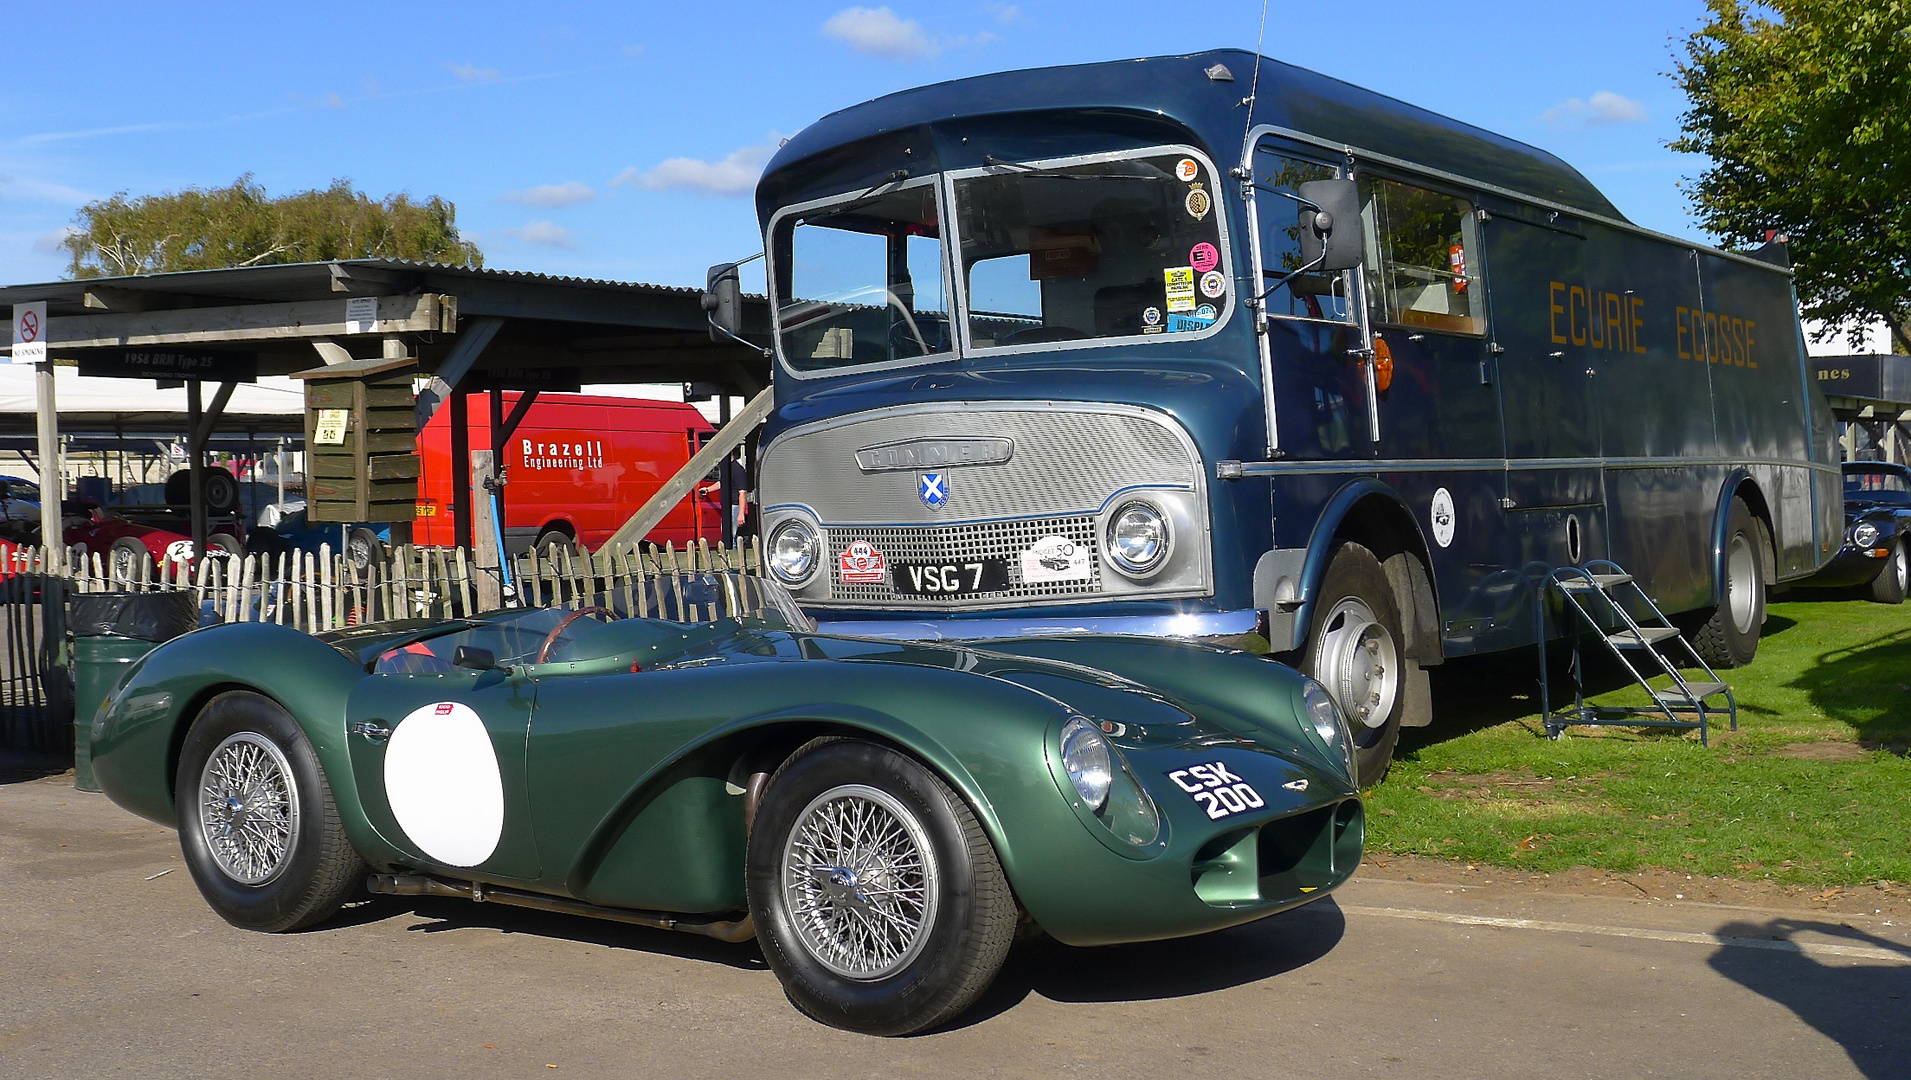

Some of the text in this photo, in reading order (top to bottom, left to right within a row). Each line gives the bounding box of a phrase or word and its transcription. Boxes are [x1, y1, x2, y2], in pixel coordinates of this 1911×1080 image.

[1550, 281, 1758, 369] ECURIE ECOSSE
[124, 353, 214, 370] 1958 BRM Type 25
[522, 439, 602, 457] Brazell
[871, 445, 995, 466] COMMER
[524, 456, 603, 471] Engineering Ltd
[853, 547, 868, 556] 444
[1032, 543, 1074, 557] MIDGET 50
[908, 563, 983, 592] VSG 7
[1168, 762, 1243, 793] CSK
[1193, 782, 1265, 820] 200
